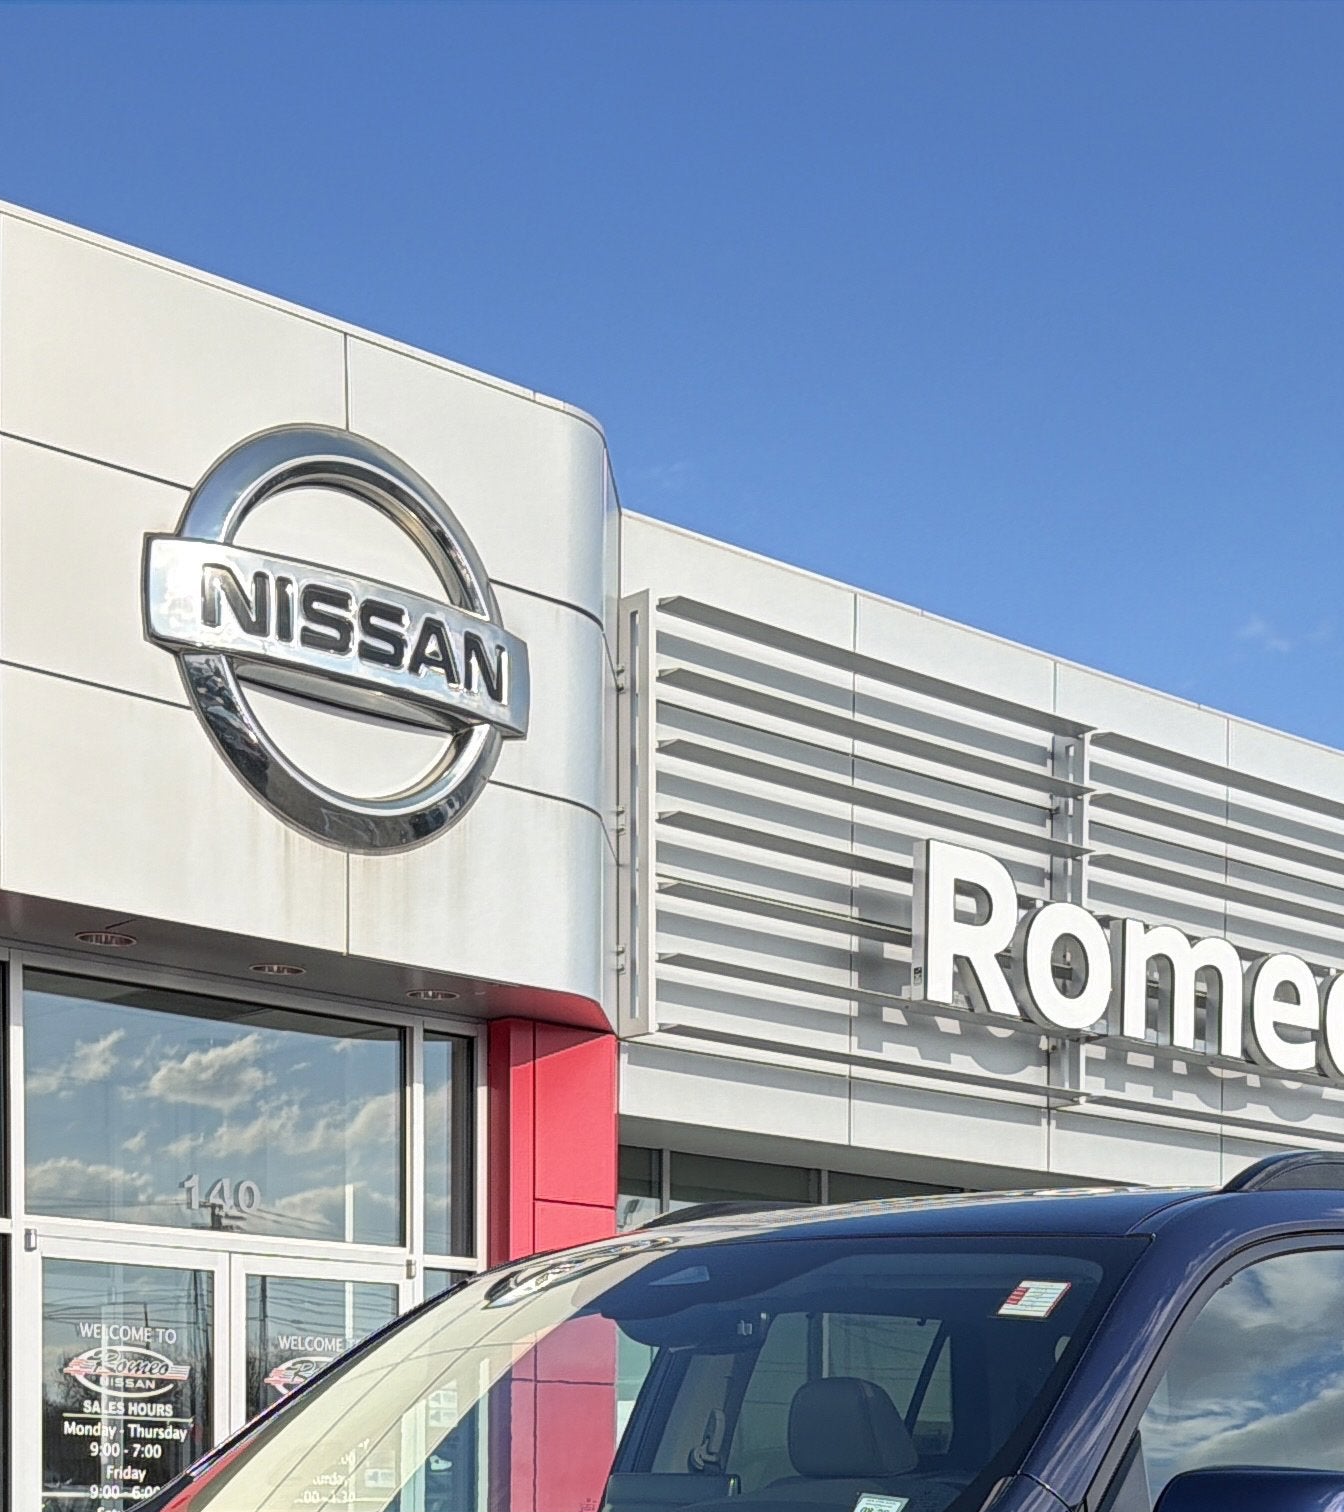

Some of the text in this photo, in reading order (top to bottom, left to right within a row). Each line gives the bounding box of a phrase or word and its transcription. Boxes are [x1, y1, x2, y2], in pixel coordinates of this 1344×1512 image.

[201, 563, 508, 705] NISSAN
[179, 1174, 260, 1213] 140
[79, 1322, 177, 1345] WELCOME TO
[278, 1335, 344, 1351] WELCOME
[87, 1348, 170, 1375] Romeo
[100, 1376, 155, 1389] NISSAN
[83, 1400, 173, 1417] SALES HOURS
[63, 1421, 116, 1440] Monday
[127, 1423, 187, 1442] Thursday
[90, 1442, 120, 1457] 9:00
[132, 1444, 162, 1458] 7:00
[106, 1465, 146, 1482] Friday
[90, 1484, 120, 1499] 9:00
